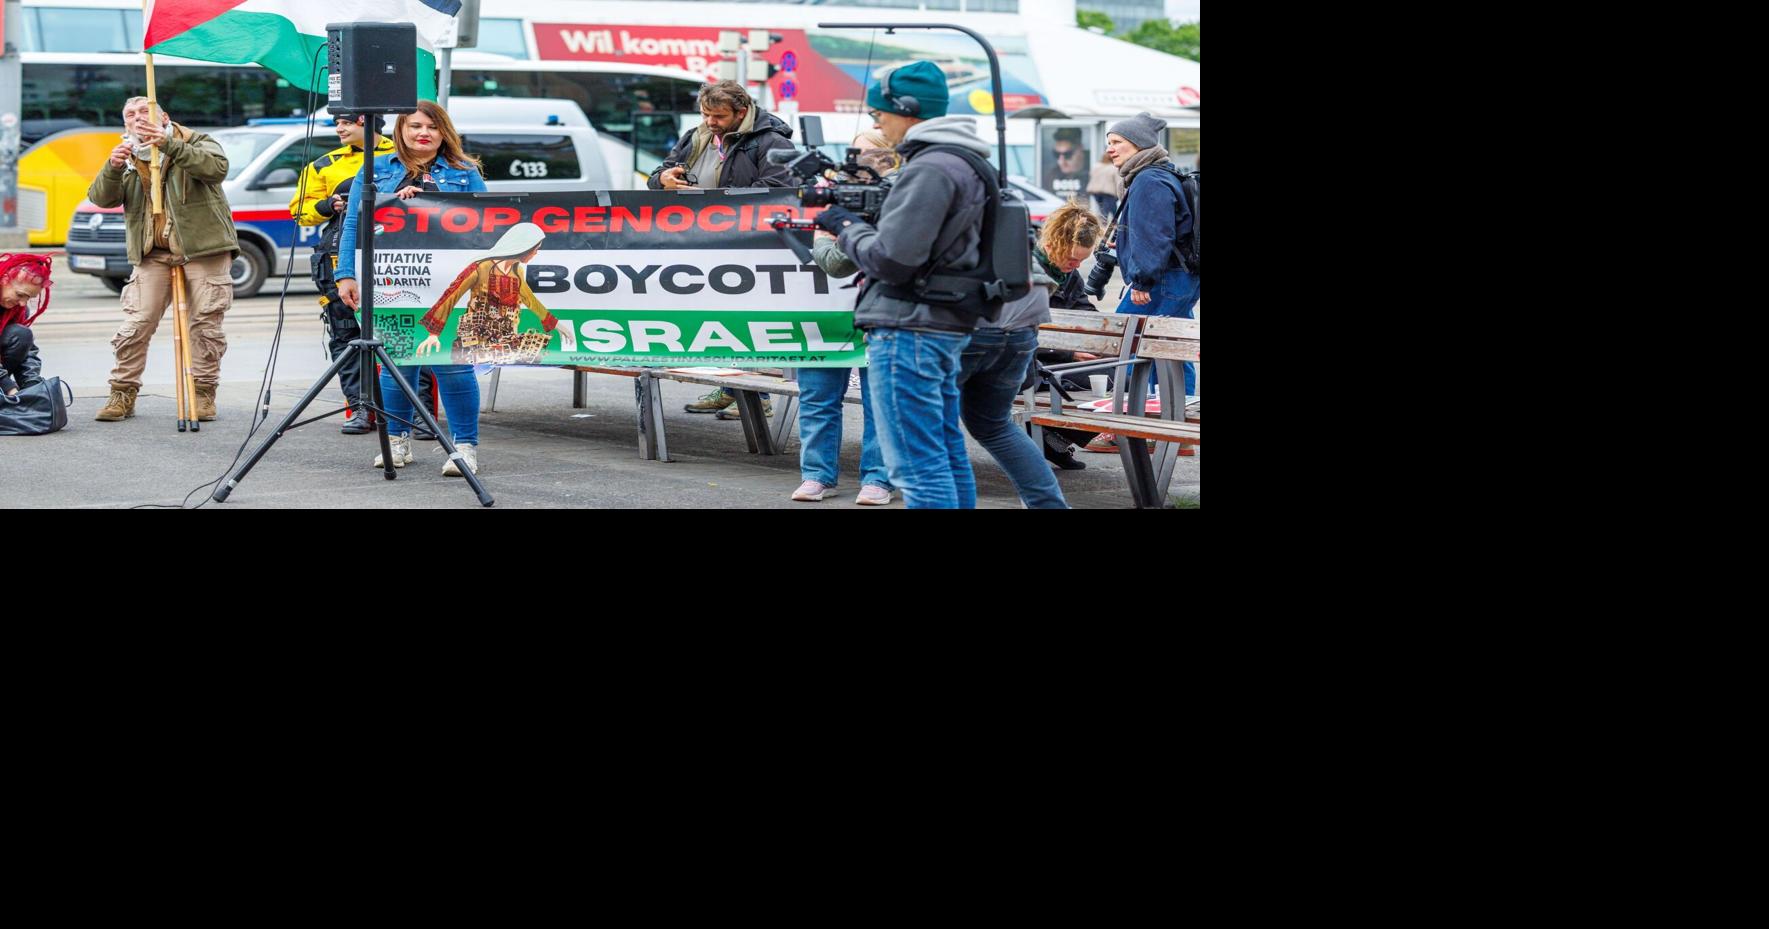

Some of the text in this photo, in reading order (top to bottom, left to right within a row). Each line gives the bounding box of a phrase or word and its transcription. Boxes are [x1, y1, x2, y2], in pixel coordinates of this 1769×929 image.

[521, 162, 548, 177] 133
[374, 206, 521, 233] STOP
[374, 253, 432, 263] ITIATIVE
[526, 264, 829, 294] BOYCOTT
[561, 320, 854, 352] ISRAEL
